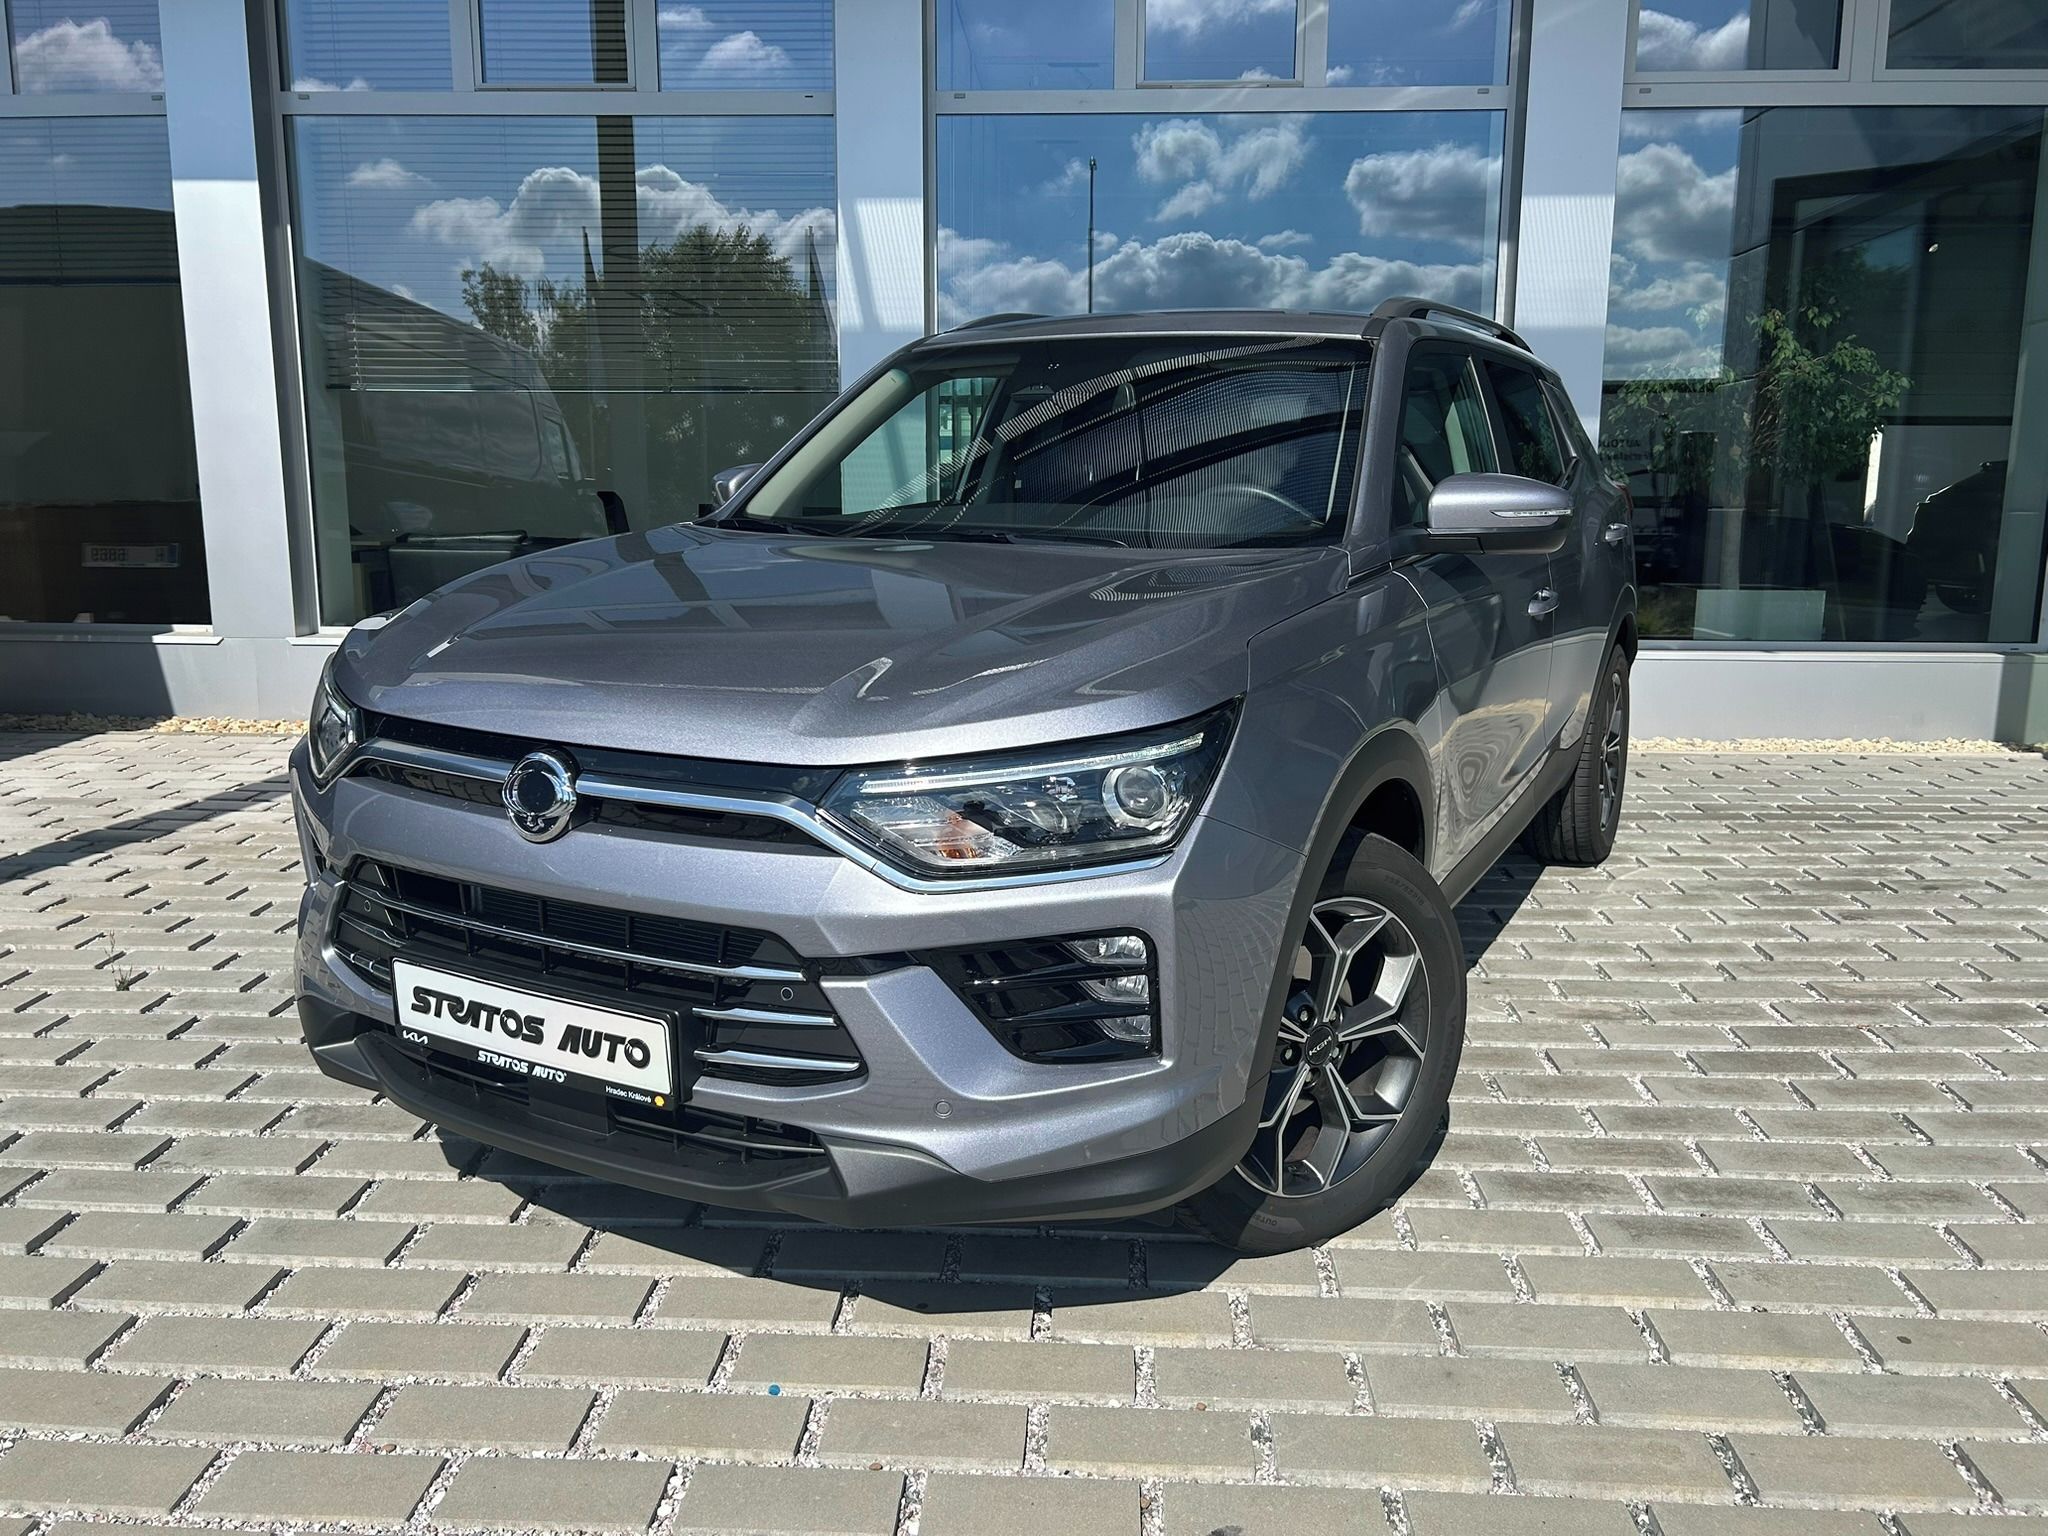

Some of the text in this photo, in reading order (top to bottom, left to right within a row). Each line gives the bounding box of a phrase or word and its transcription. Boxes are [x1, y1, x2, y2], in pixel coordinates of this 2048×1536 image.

[410, 985, 652, 1070] STRATOS AUTO
[477, 1050, 566, 1083] STRATOS AUTO
[605, 1085, 628, 1098] Hradec
